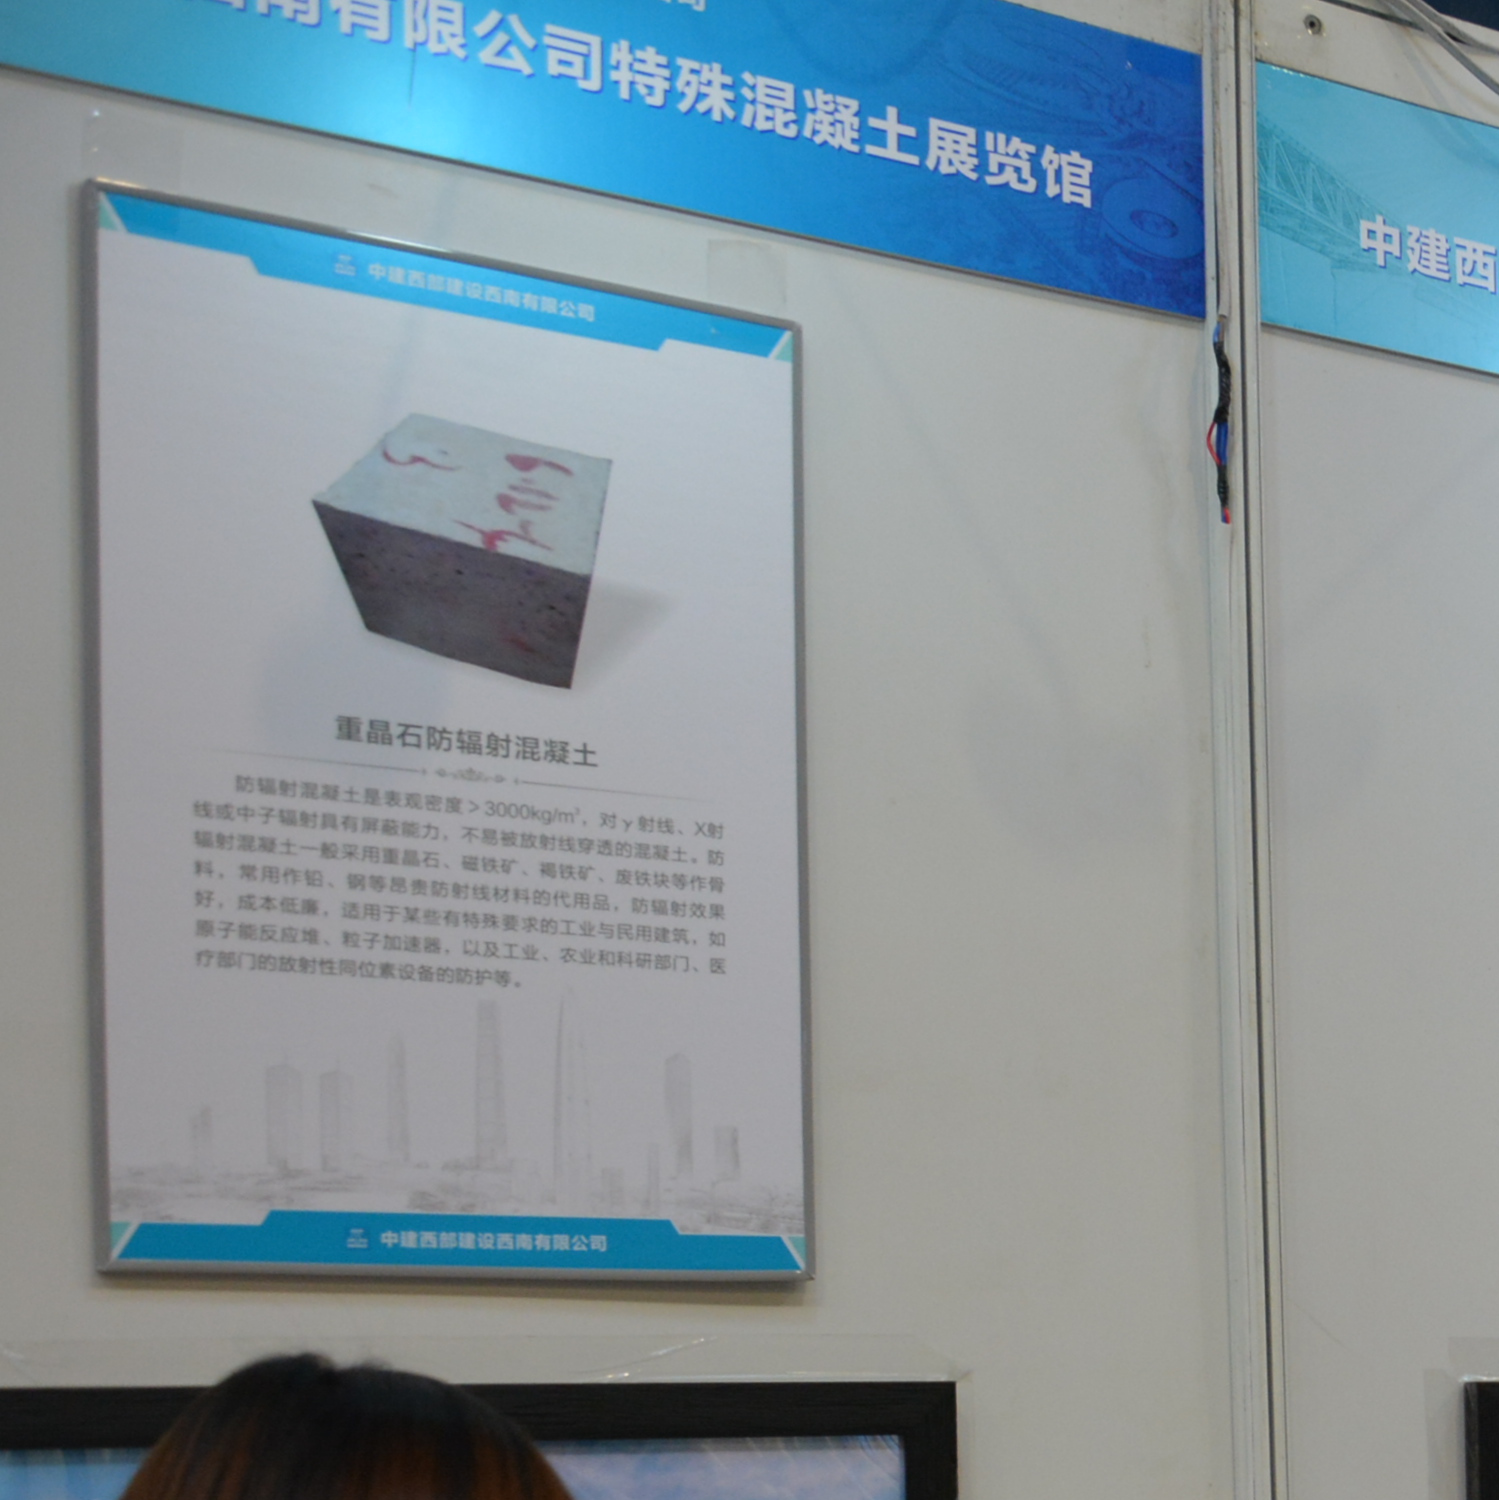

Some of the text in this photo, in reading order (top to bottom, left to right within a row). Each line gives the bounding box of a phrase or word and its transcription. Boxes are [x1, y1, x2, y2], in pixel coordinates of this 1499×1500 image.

[335, 714, 599, 768] 重晶石防辐射混凝土
